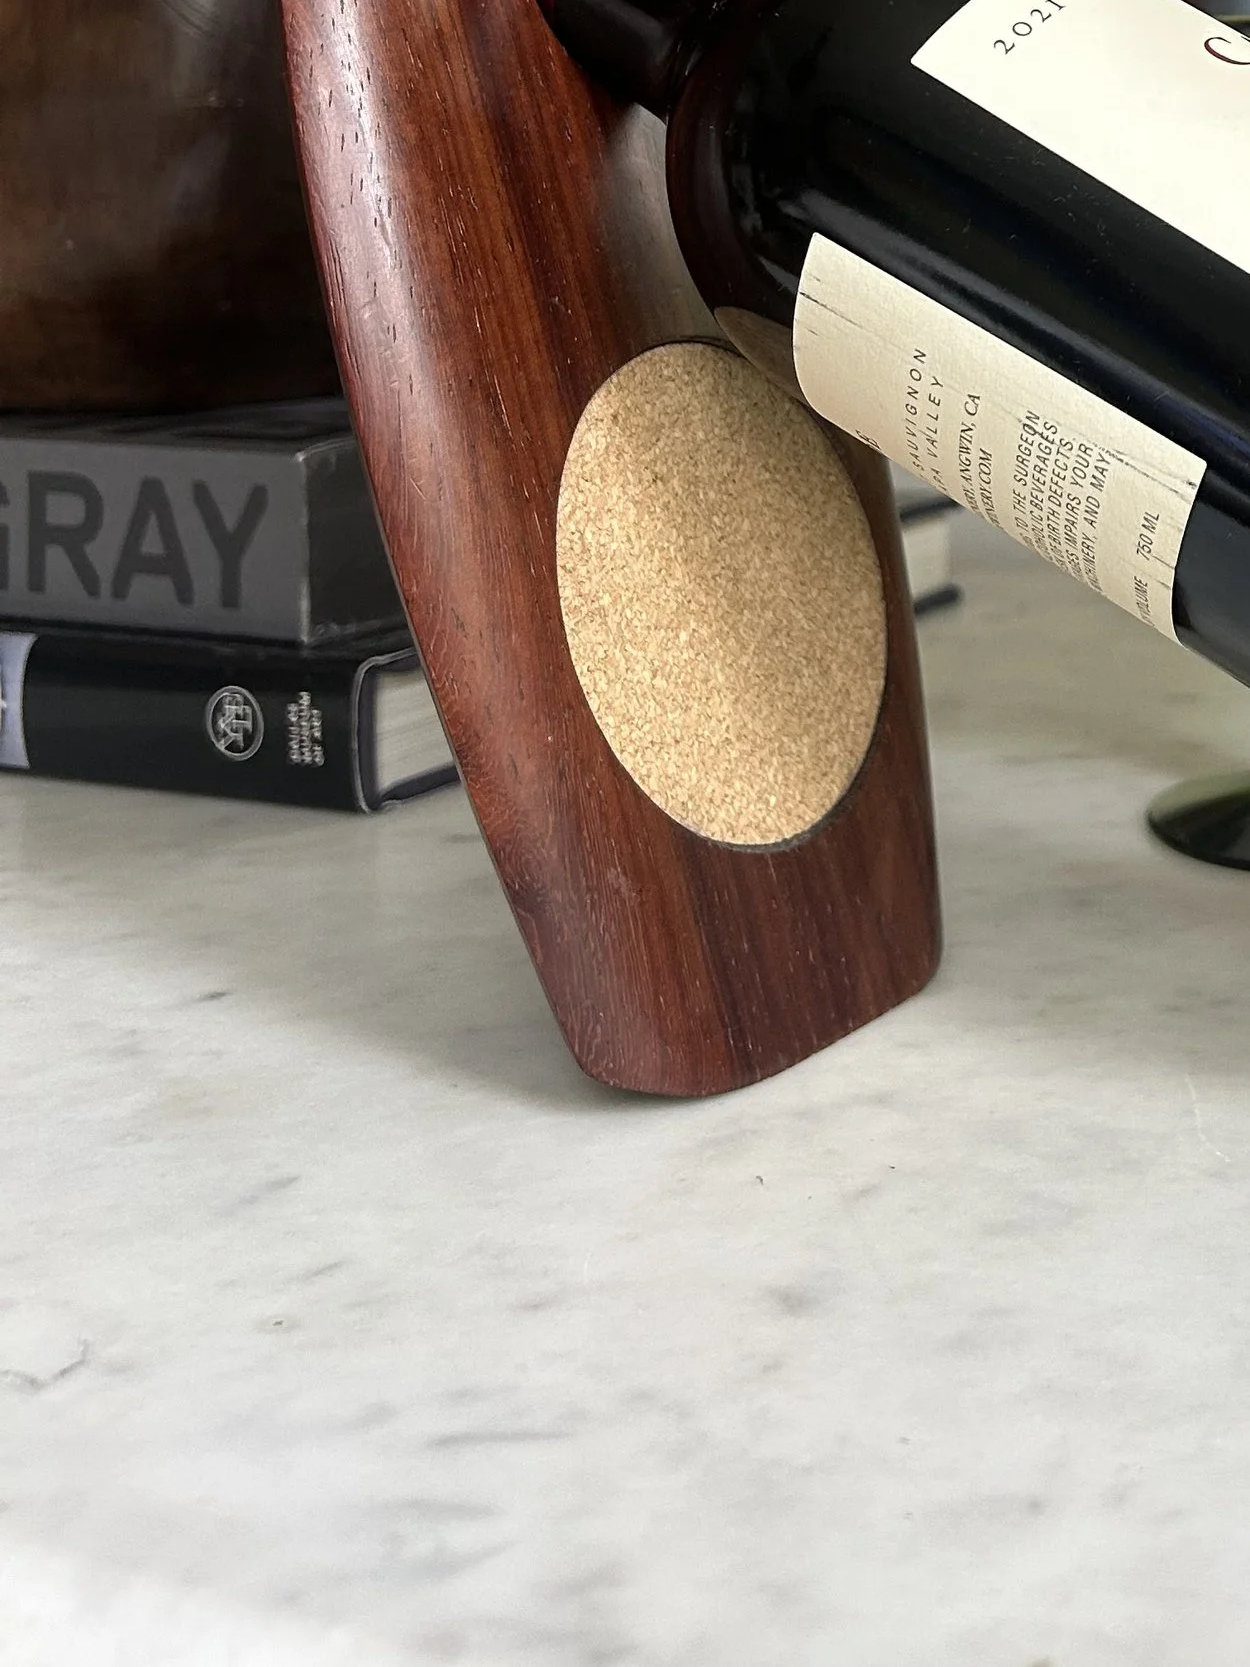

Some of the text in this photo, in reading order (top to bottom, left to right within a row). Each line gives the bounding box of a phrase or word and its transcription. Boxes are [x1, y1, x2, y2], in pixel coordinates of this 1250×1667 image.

[905, 348, 927, 472] SAUVIGNON
[926, 376, 944, 459] VALLEY
[964, 393, 981, 417] CA
[958, 422, 977, 487] ANGWIN,
[1013, 410, 1041, 487] SURGEON
[1029, 421, 1058, 512] BEVERAGES
[1070, 442, 1094, 488] YOUR
[1090, 451, 1111, 492] MAY
[1012, 488, 1027, 515] THE
[1064, 492, 1082, 551] IMPAIRS
[1083, 495, 1101, 530] AND
[1141, 511, 1160, 535] ML
[0, 470, 269, 609] RAY
[1014, 516, 1029, 533] TO
[1047, 506, 1062, 547] BIRTH
[1136, 532, 1154, 561] 750
